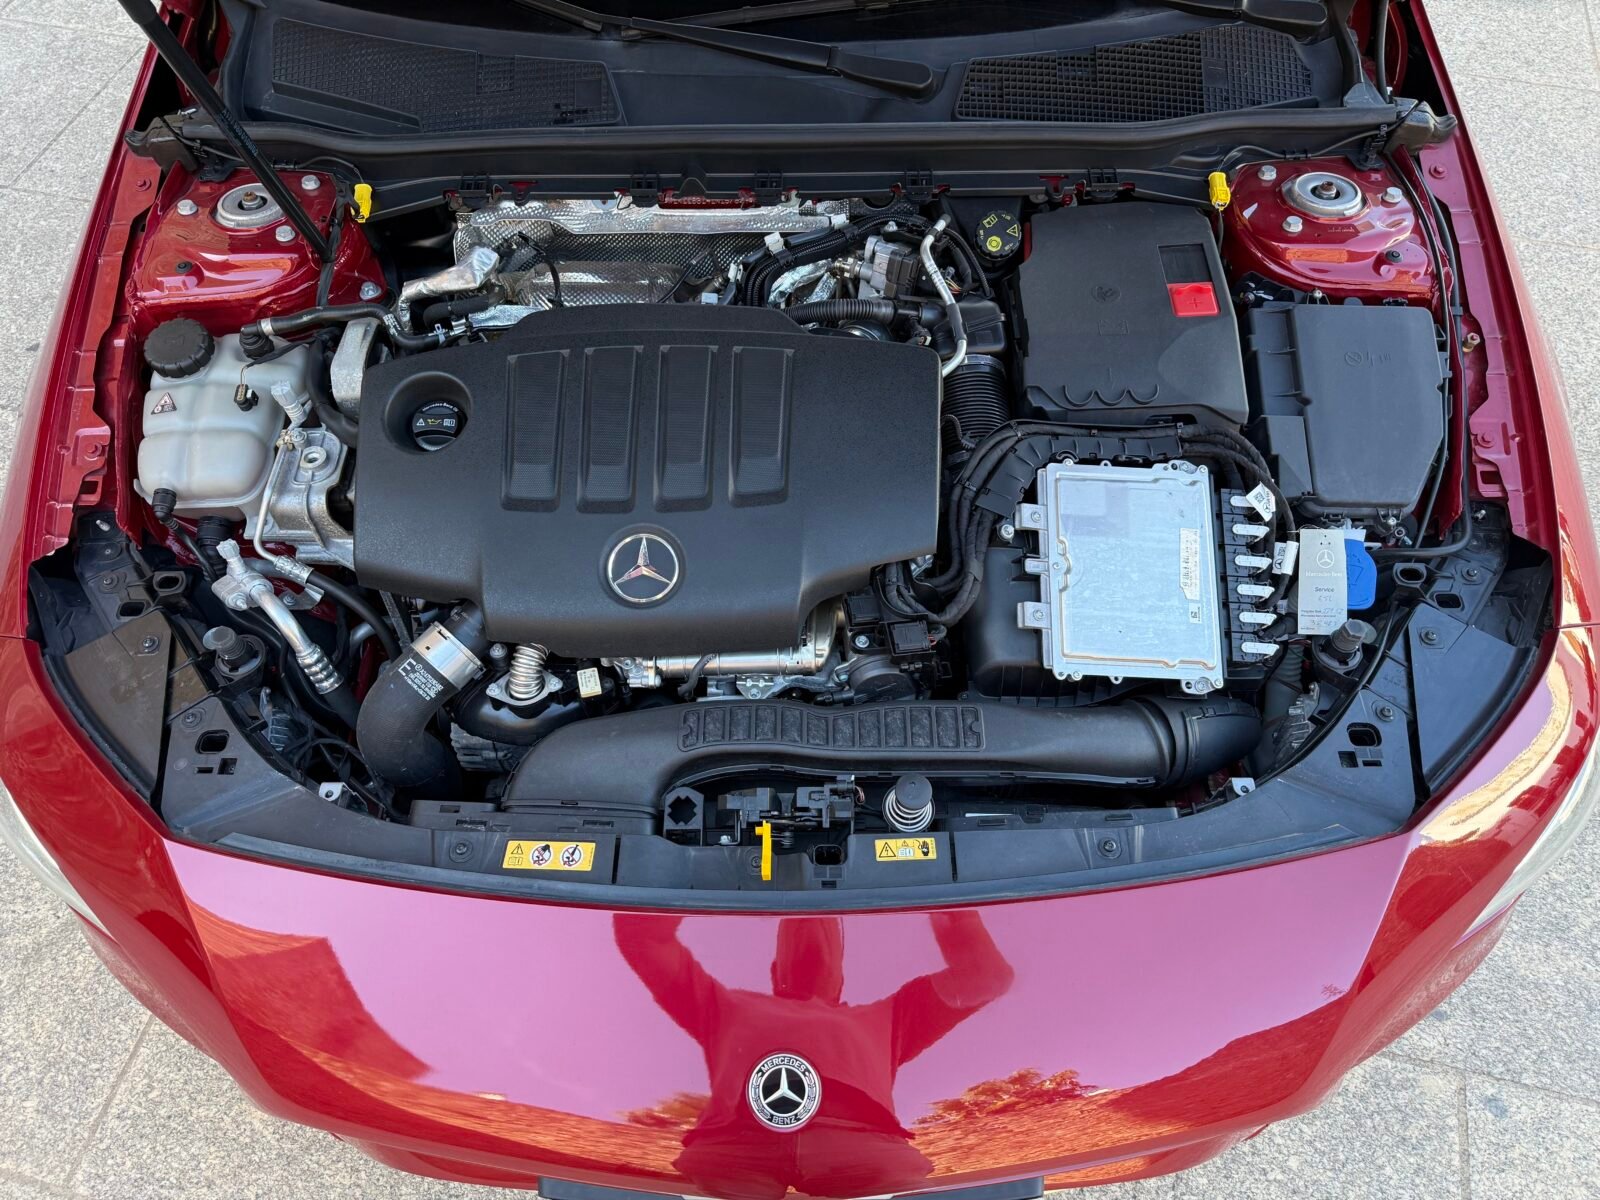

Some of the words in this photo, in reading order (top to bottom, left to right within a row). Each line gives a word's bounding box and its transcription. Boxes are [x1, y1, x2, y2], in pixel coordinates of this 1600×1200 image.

[398, 658, 416, 676] E
[761, 1057, 806, 1072] MERCEDES
[772, 1115, 797, 1125] BENZ
